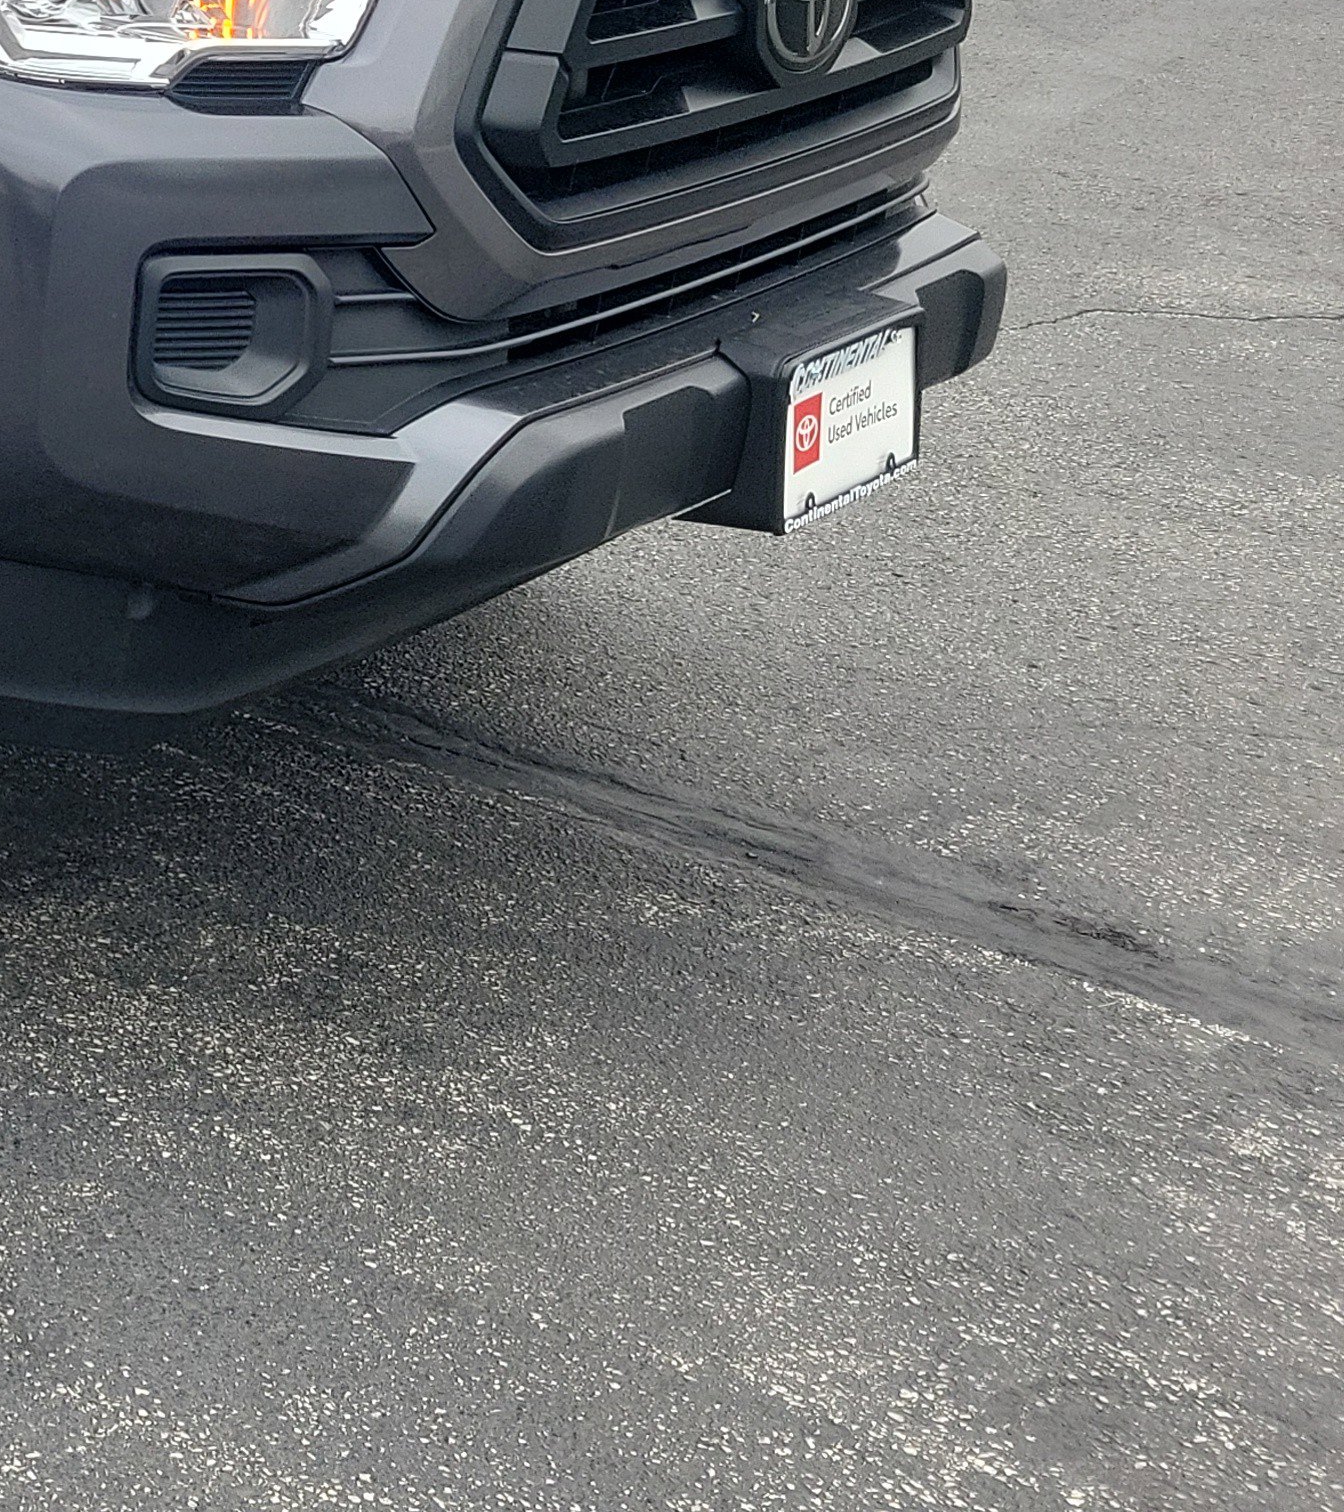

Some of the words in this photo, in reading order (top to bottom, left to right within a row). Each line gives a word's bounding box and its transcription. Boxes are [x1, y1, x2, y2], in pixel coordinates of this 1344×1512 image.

[828, 380, 872, 416] Certified
[827, 415, 853, 444] Used
[854, 401, 898, 432] Vehicles
[784, 459, 917, 534] ContinentalToyota.com
